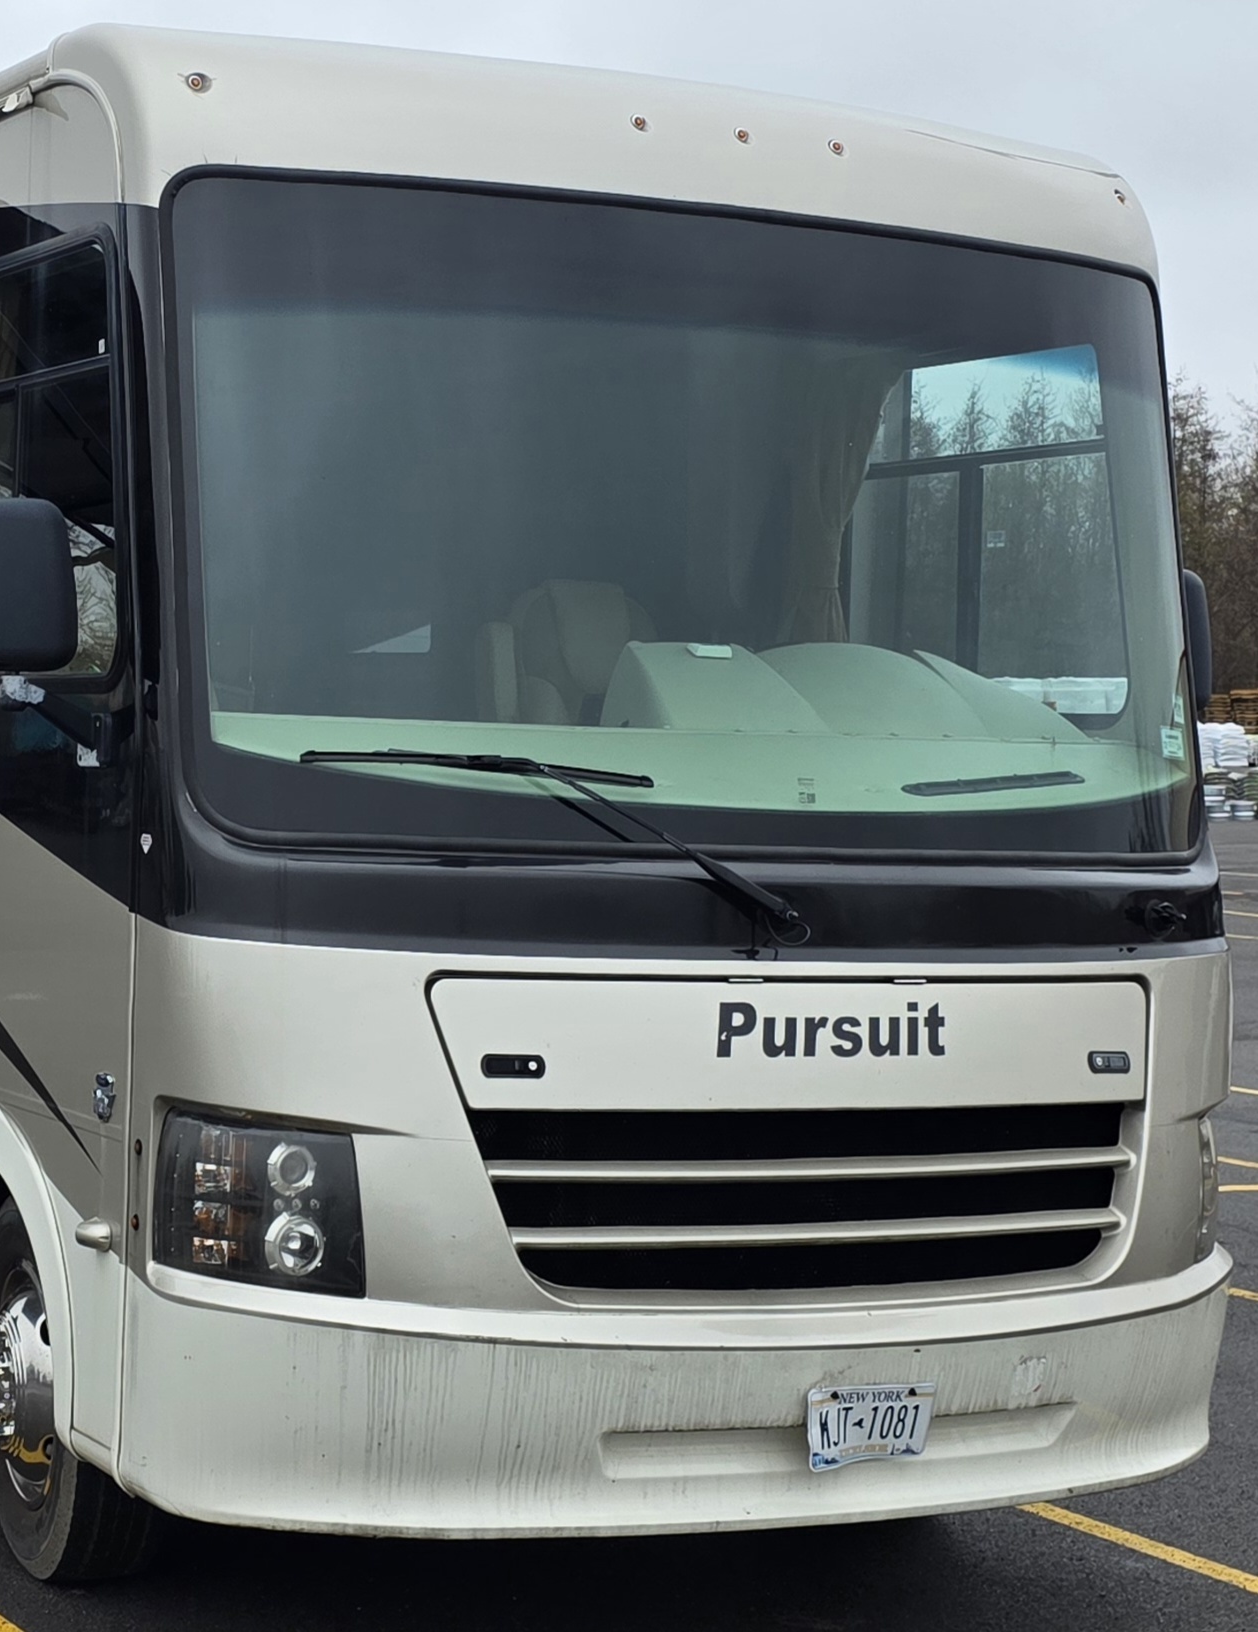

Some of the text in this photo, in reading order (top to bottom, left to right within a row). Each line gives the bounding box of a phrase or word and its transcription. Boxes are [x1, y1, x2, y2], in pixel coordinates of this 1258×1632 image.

[716, 1001, 946, 1058] Pursuit
[838, 1390, 906, 1405] NEW YORK
[819, 1404, 920, 1450] KJT 1081
